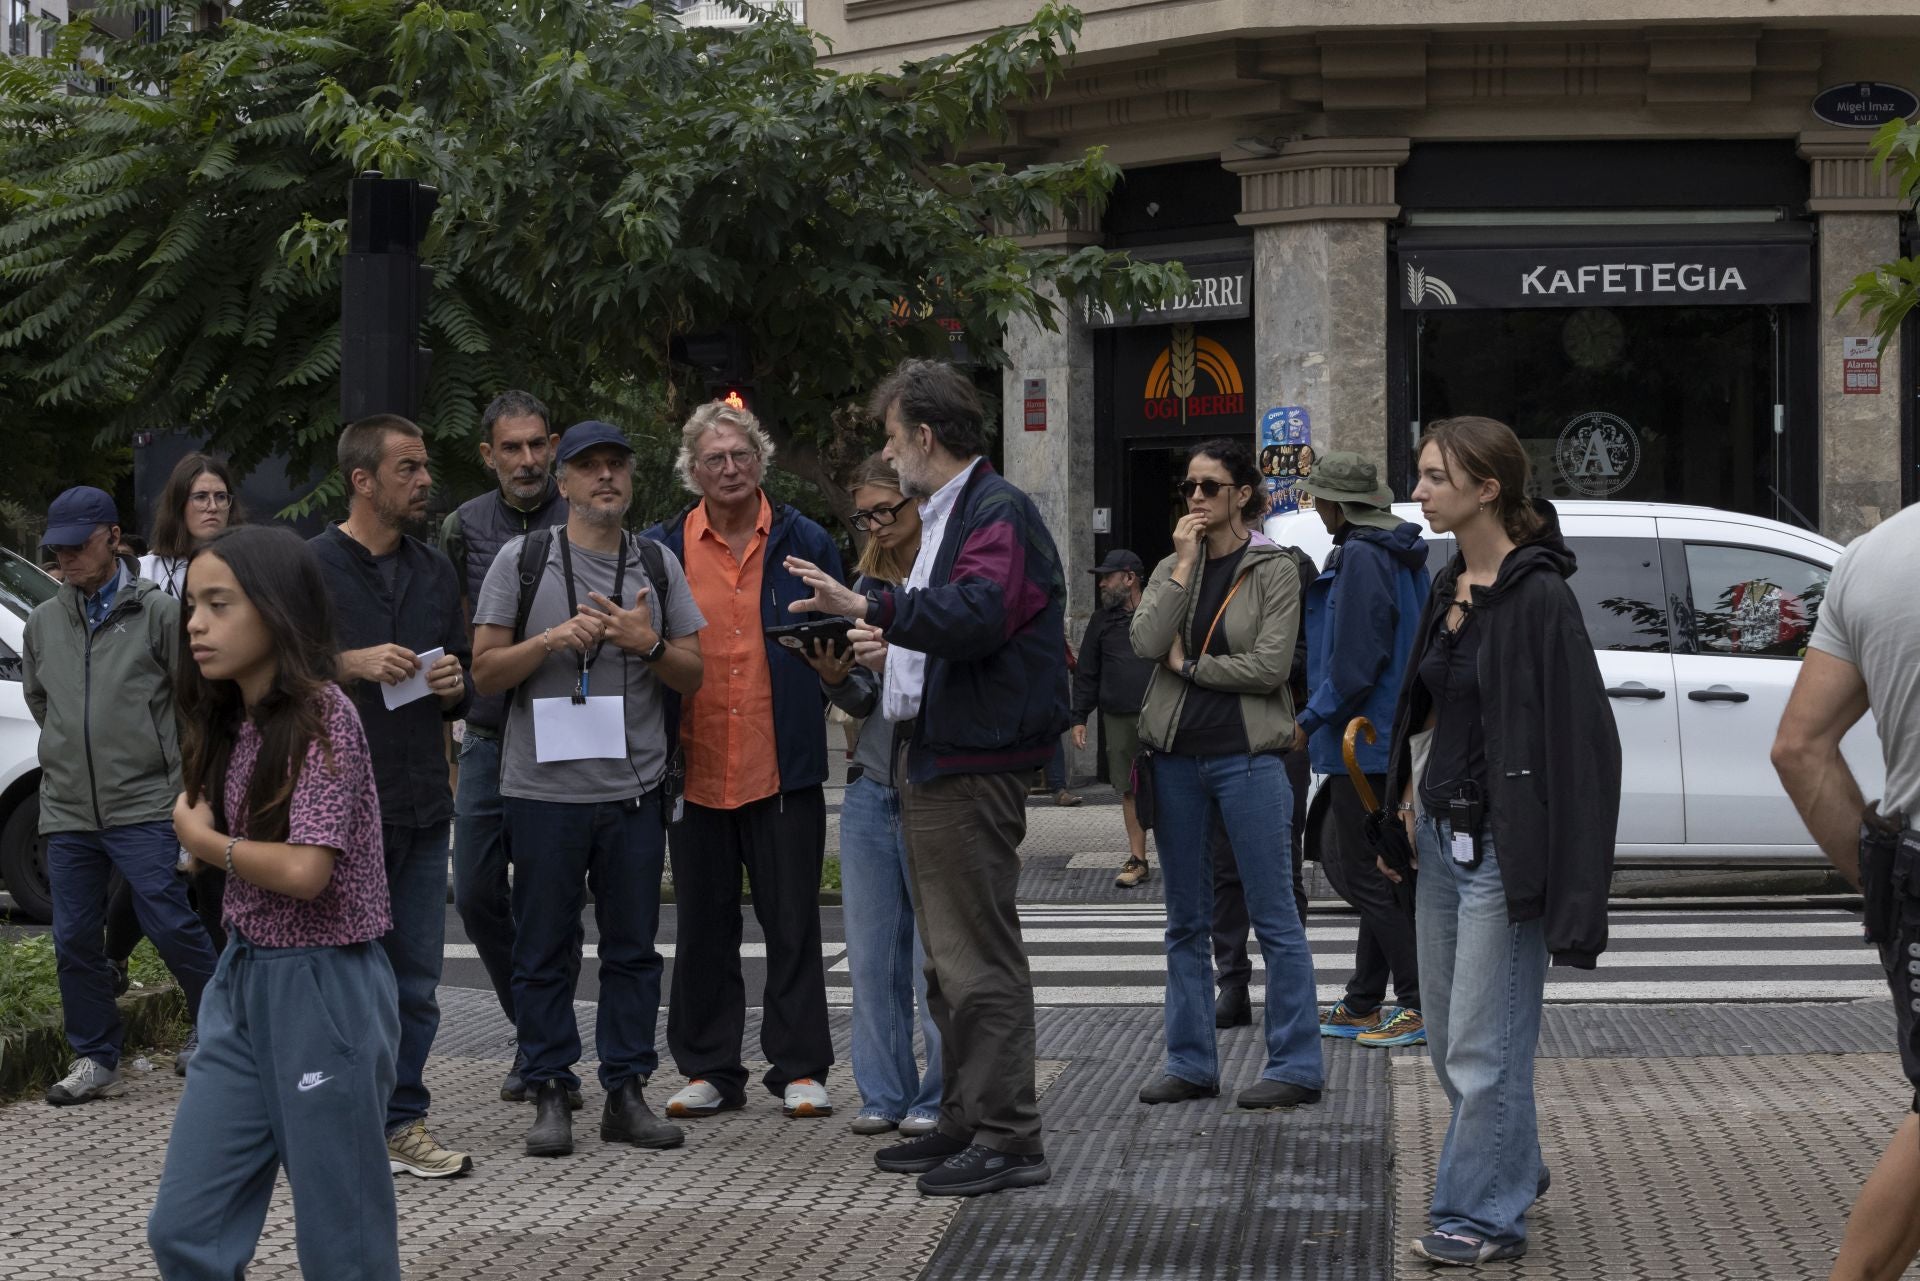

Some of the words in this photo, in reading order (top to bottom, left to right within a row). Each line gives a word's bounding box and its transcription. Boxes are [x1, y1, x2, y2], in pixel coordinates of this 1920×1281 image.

[1837, 101, 1865, 114] Migel
[1869, 101, 1895, 111] Imaz
[1521, 263, 1746, 295] KAFETEGIA
[1847, 360, 1878, 369] Alarma
[1144, 398, 1179, 420] OGI
[1187, 394, 1245, 417] BERRI
[302, 1071, 324, 1085] NIKE
